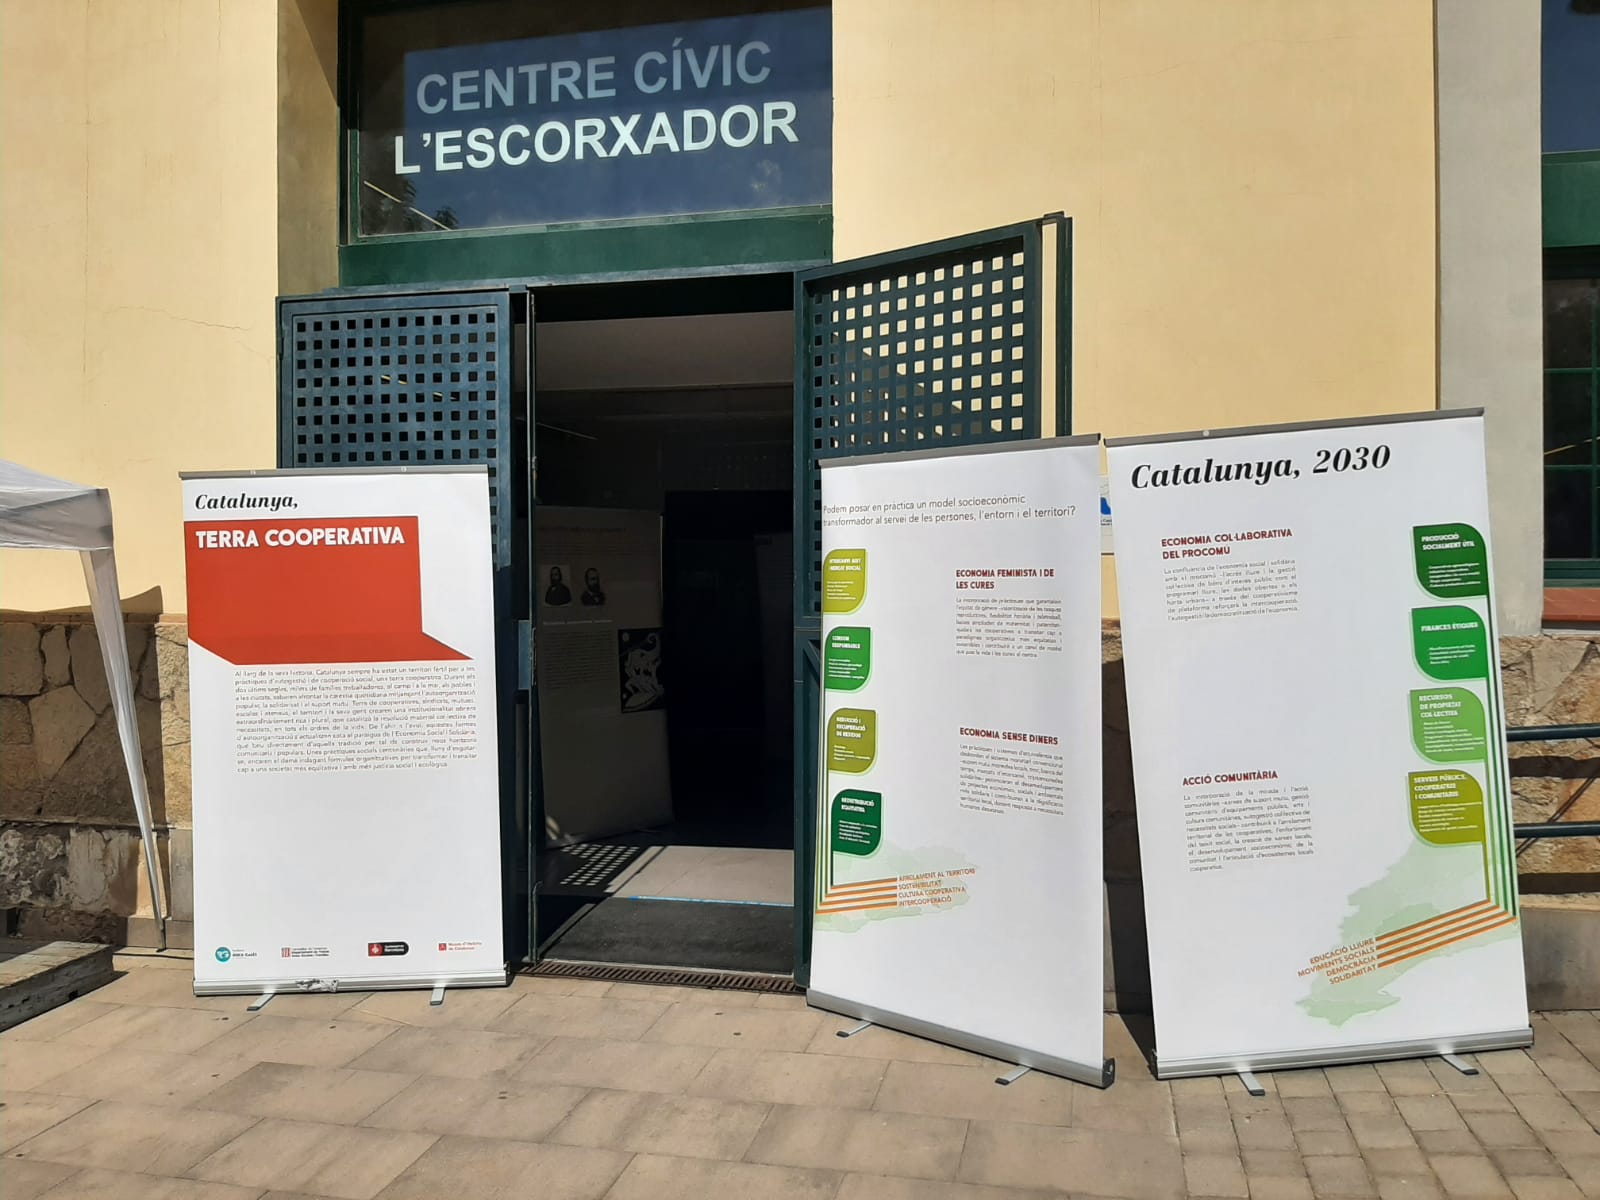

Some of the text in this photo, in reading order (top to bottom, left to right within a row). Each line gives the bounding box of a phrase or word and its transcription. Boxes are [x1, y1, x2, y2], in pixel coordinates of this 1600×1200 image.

[416, 37, 771, 115] CENTRE CÍVIC
[394, 101, 799, 175] L'ESCORXADOR
[1131, 444, 1391, 488] Catalunya, 2030
[195, 493, 299, 512] Catalunya,
[823, 495, 1025, 514] Podem posar en pràctica un model socioeconòmic
[823, 516, 874, 526] transformador
[875, 515, 882, 525] al
[884, 514, 907, 525] servei
[909, 513, 919, 523] de
[921, 513, 933, 522] les
[935, 510, 976, 524] persones,
[979, 510, 1014, 520] l'entorn
[1022, 508, 1031, 518] el
[1034, 505, 1076, 517] territori?
[195, 526, 405, 549] TERRA COOPERATIVA
[1161, 528, 1292, 547] ECONOMIA COL·LABORATIVA
[1421, 533, 1460, 542] PRODUCCIÓ
[1423, 542, 1461, 550] SOCIALMENT
[1162, 545, 1230, 560] DEL PROCOMÚ
[956, 569, 1054, 577] ECONOMIA FEMINISTA I DE
[956, 581, 994, 589] LES CURES
[1419, 694, 1453, 702] RECURSOS
[1430, 701, 1461, 709] PROPIETAT
[960, 727, 1058, 745] ECONOMIA SENSE DINERS
[1183, 770, 1278, 786] ACCIÓ COMUNITÀRIA
[1414, 776, 1439, 784] SERVEIS
[898, 886, 966, 898] CULTURA COOPERATIVA
[899, 895, 952, 907] INTERCOOPERACIÓ
[1309, 938, 1374, 964] EDUCACIÓ LLIURE
[1298, 946, 1375, 977] MOVIMENTS SOCIALS
[1326, 955, 1376, 977] DEMOCRÀCIA
[1329, 964, 1377, 985] SOLIDARITAT
